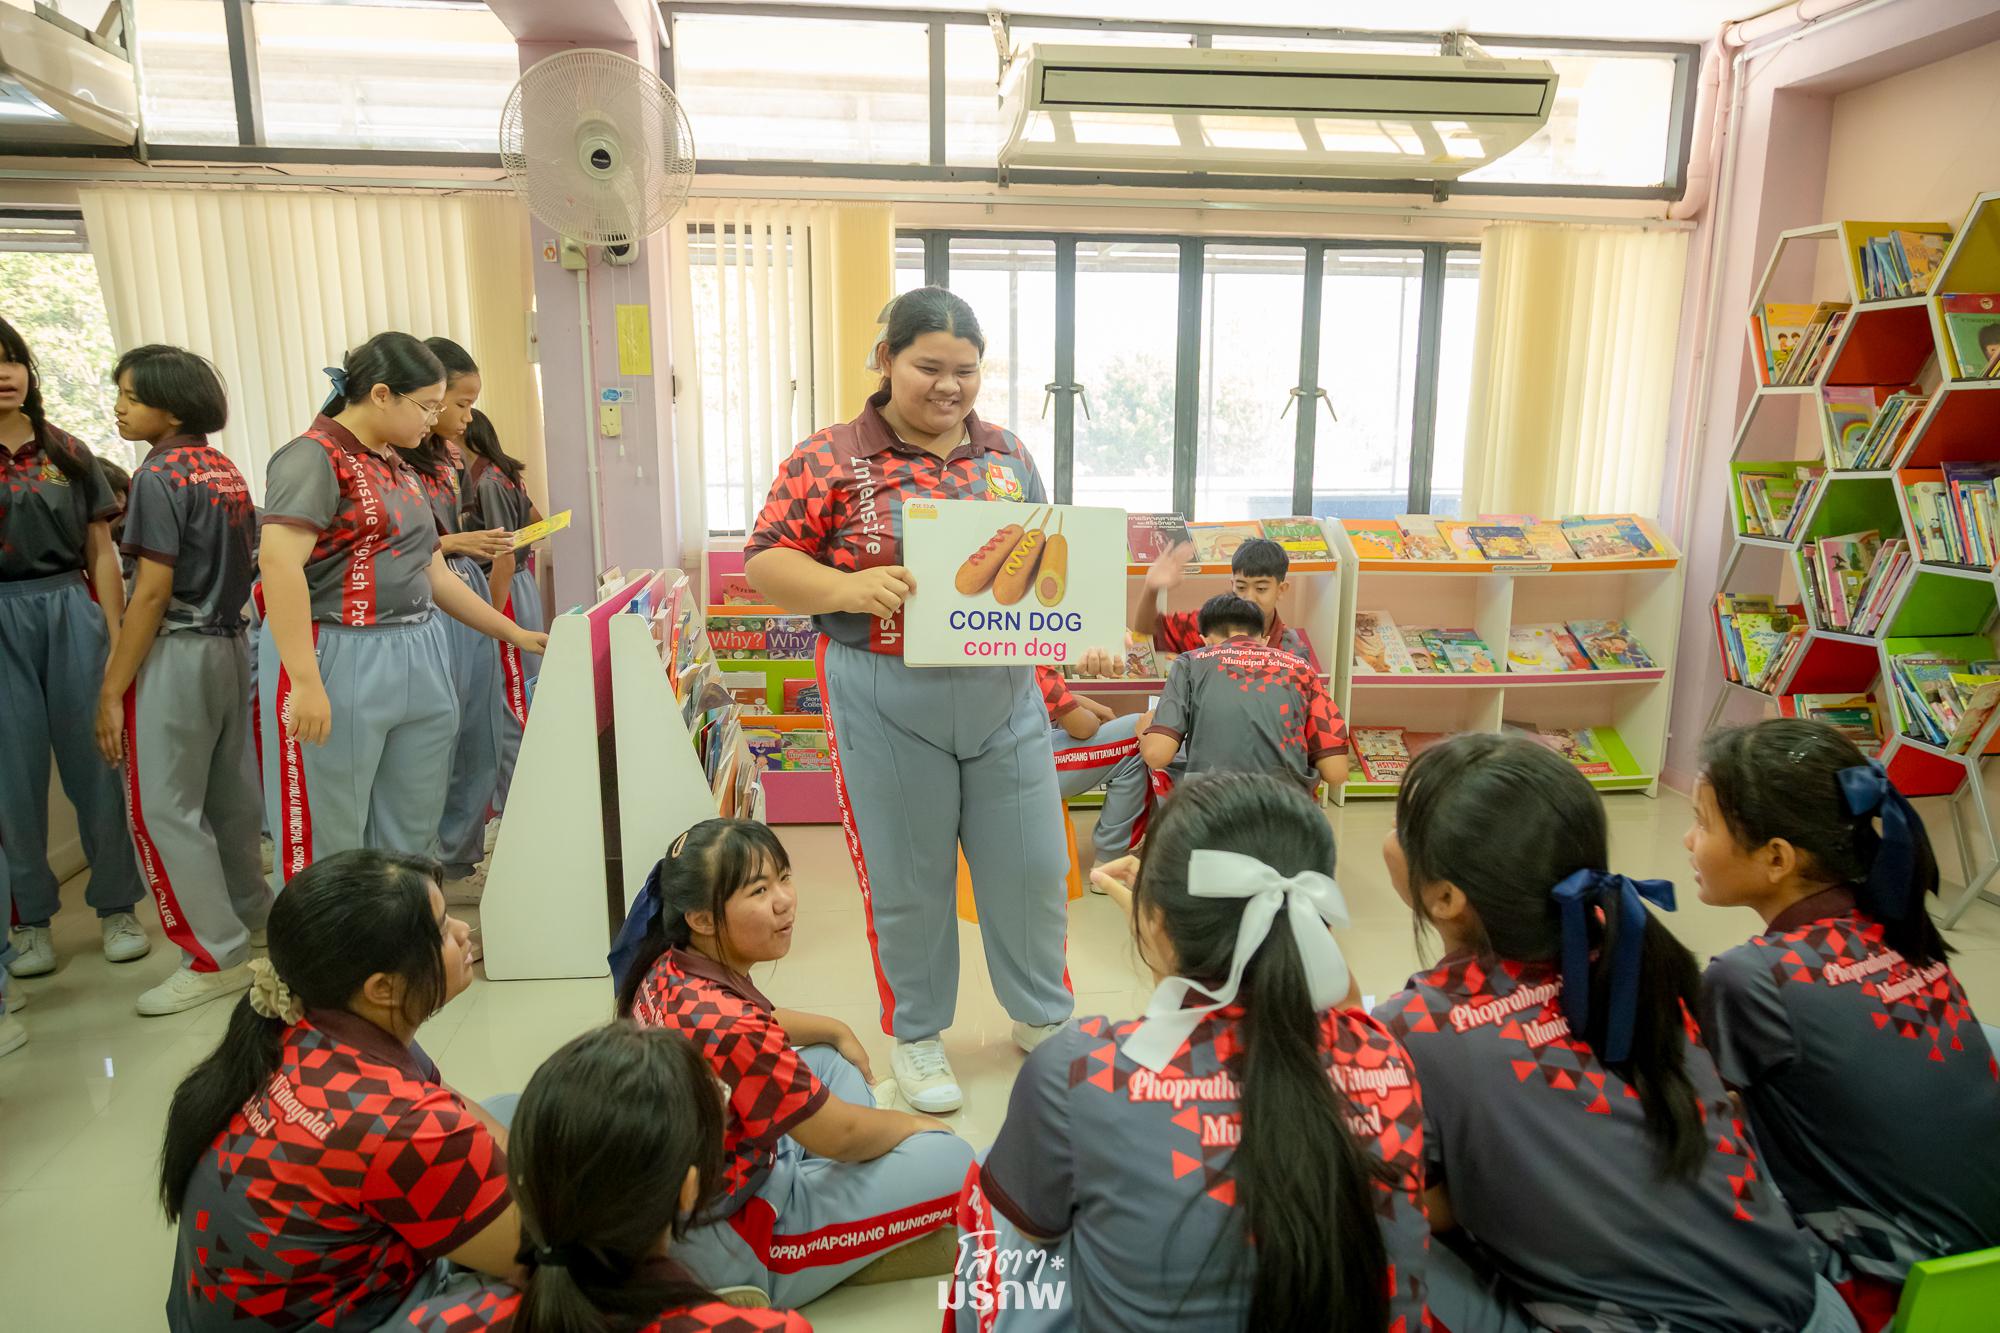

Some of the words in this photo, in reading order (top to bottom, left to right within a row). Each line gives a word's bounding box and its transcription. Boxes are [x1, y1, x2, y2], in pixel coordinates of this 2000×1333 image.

[950, 610, 1020, 631] CORN
[1029, 612, 1082, 632] DOG
[711, 631, 763, 648] Why?
[964, 640, 1016, 656] corn
[1024, 637, 1067, 662] dog
[1222, 657, 1265, 668] Municipal
[1267, 659, 1295, 670] School
[1089, 748, 1121, 760] WITTAYALAI
[290, 806, 303, 844] MUNICIPAL
[292, 845, 305, 874] SCHOOL
[156, 887, 177, 928] COLLEGE
[1326, 1060, 1411, 1098] Wittayalai
[268, 1073, 336, 1140] Wittayalai
[769, 1227, 885, 1260] OPRATHAPCHANG
[888, 1207, 953, 1236] MUNICIPAL
